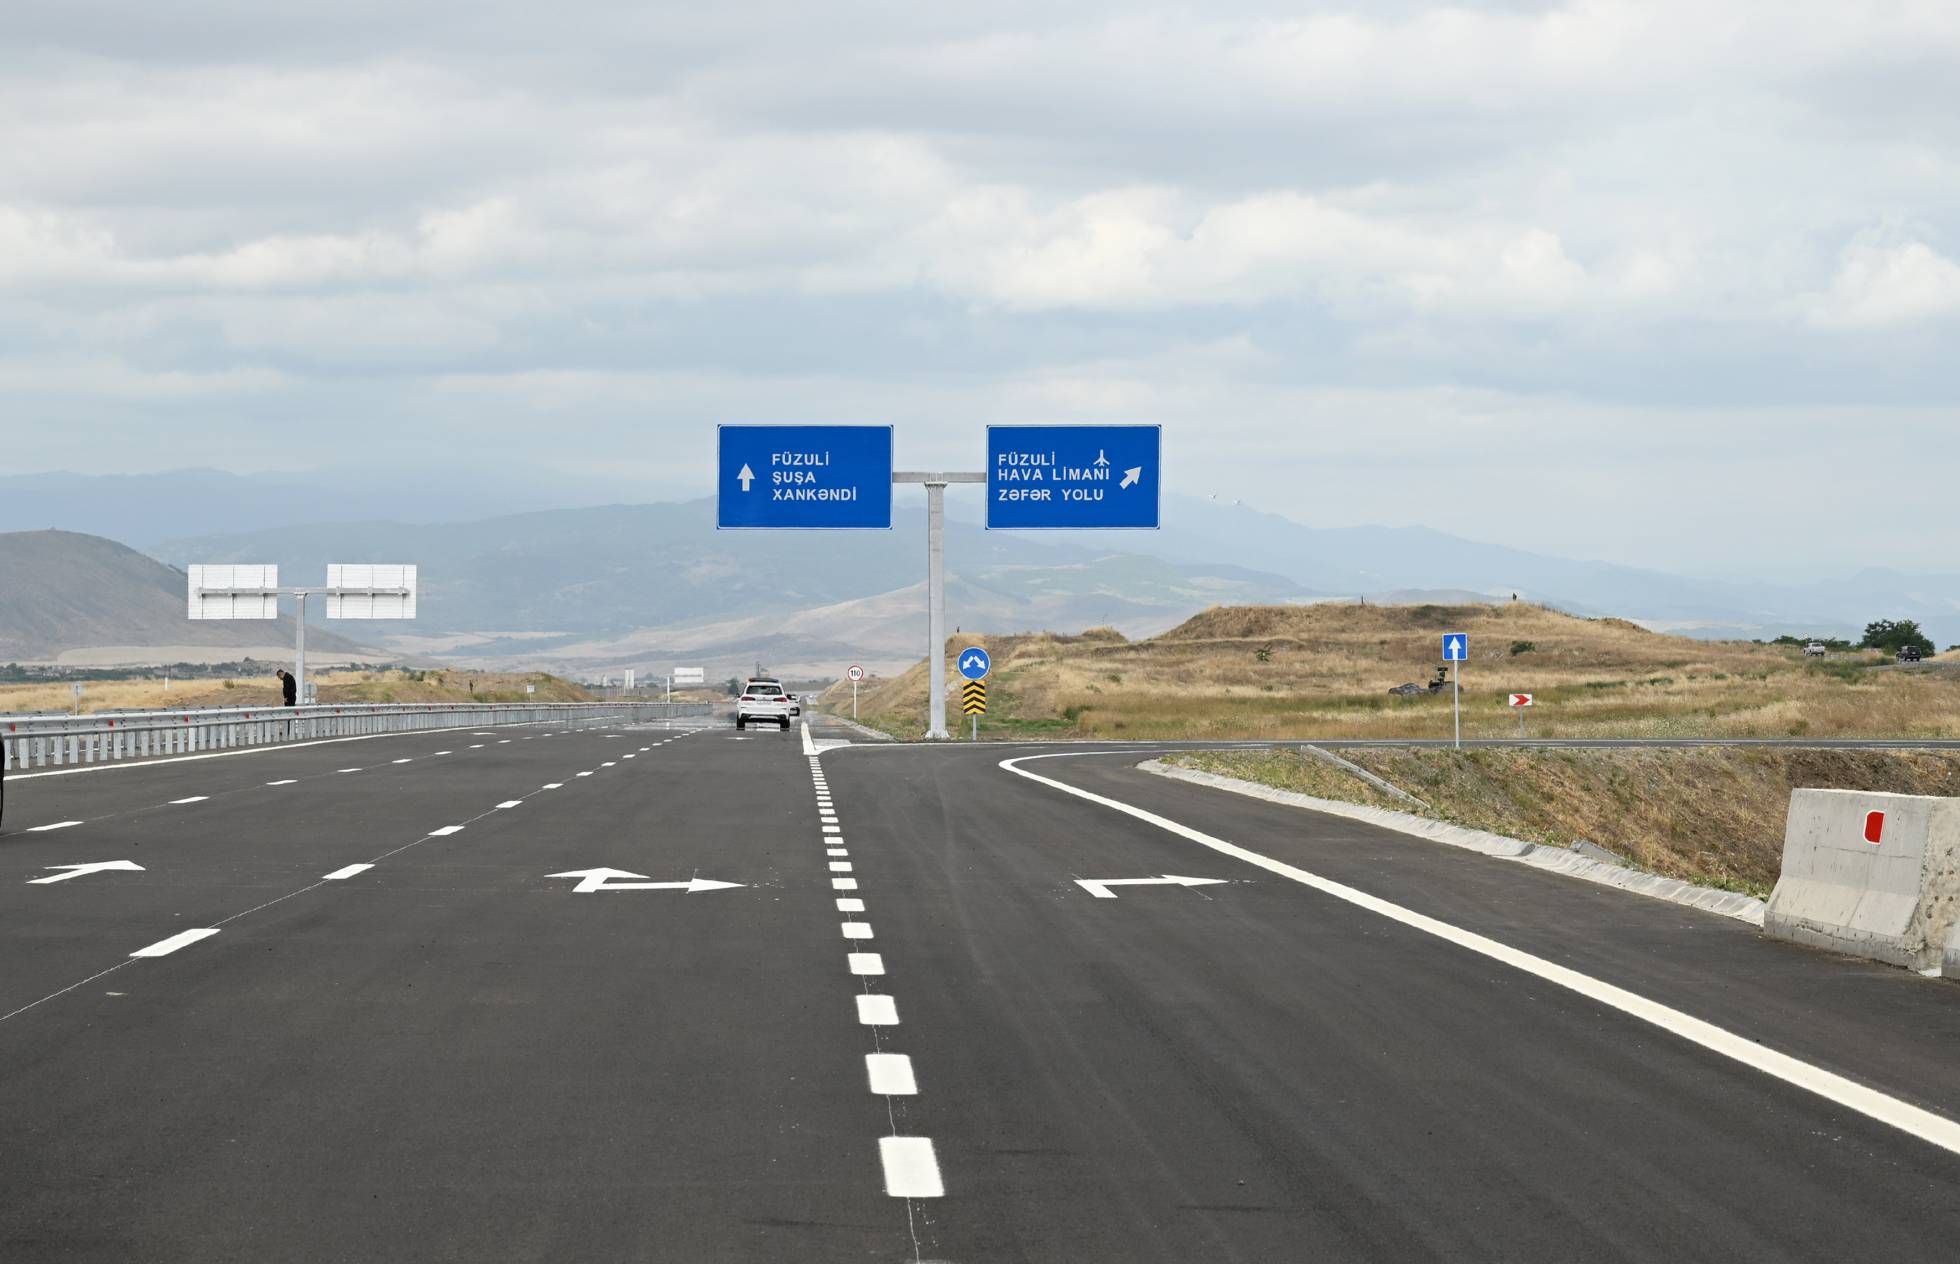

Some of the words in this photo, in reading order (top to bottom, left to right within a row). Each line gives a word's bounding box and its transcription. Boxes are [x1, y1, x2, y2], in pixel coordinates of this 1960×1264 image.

[772, 451, 829, 466] FÜZULİ
[998, 451, 1055, 466] FÜZULİ
[772, 471, 816, 485] ŞUŞA
[998, 468, 1043, 481] HAVA
[1052, 467, 1110, 481] LİMANI
[772, 486, 857, 501] XANKƏNDİ
[998, 489, 1051, 501] ZƏFƏR
[1061, 489, 1104, 501] YOLU
